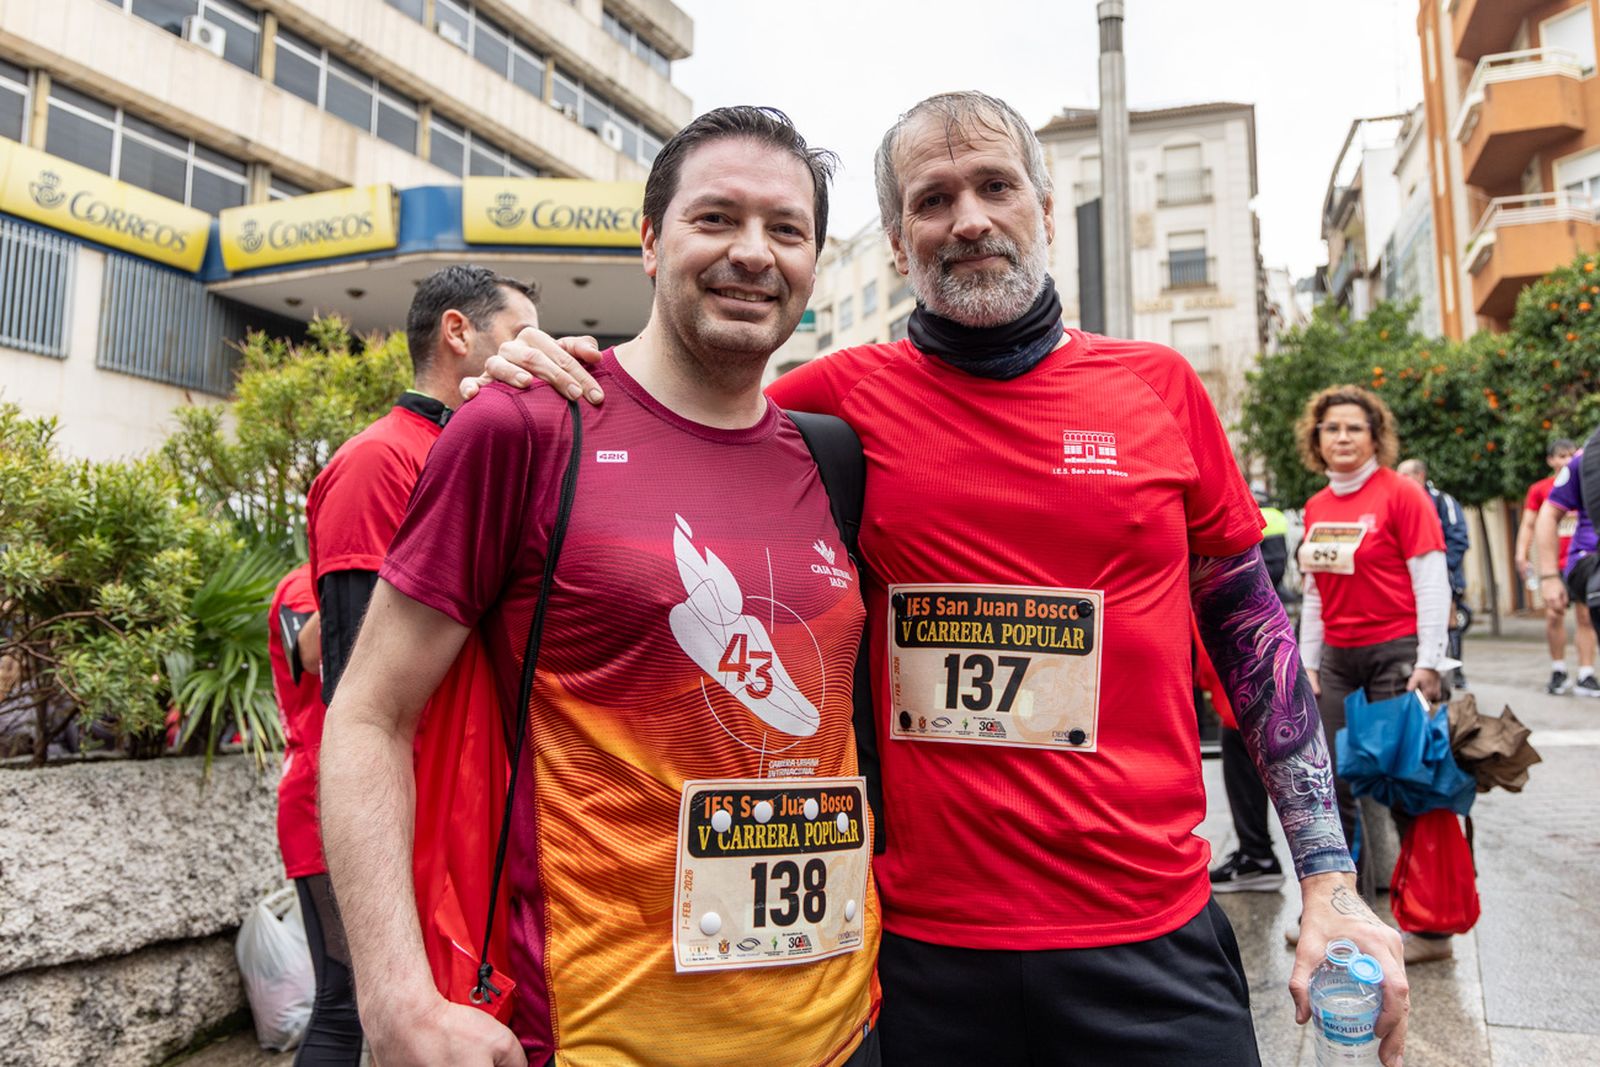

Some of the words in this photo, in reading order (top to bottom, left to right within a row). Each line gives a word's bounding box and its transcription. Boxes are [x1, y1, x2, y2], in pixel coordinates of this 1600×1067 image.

[69, 189, 190, 254] CORREOS
[267, 209, 374, 251] CORREOS
[1071, 467, 1086, 475] San
[1087, 467, 1105, 475] Juan
[906, 596, 931, 617] IES
[936, 597, 969, 617] San
[974, 597, 1018, 618] Juan
[1025, 599, 1081, 621] Bosco
[902, 621, 913, 642] V
[917, 620, 995, 645] CARRERA
[1000, 623, 1086, 650] POPULAR
[718, 633, 773, 700] 43
[944, 653, 1032, 713] 137
[704, 795, 734, 819] IES
[779, 793, 817, 817] Jua
[820, 791, 854, 814] Bosco
[698, 825, 712, 851] V
[717, 822, 800, 851] CARRERA
[804, 818, 859, 847] POPULAR
[683, 868, 694, 892] 2026
[751, 857, 827, 928] 138
